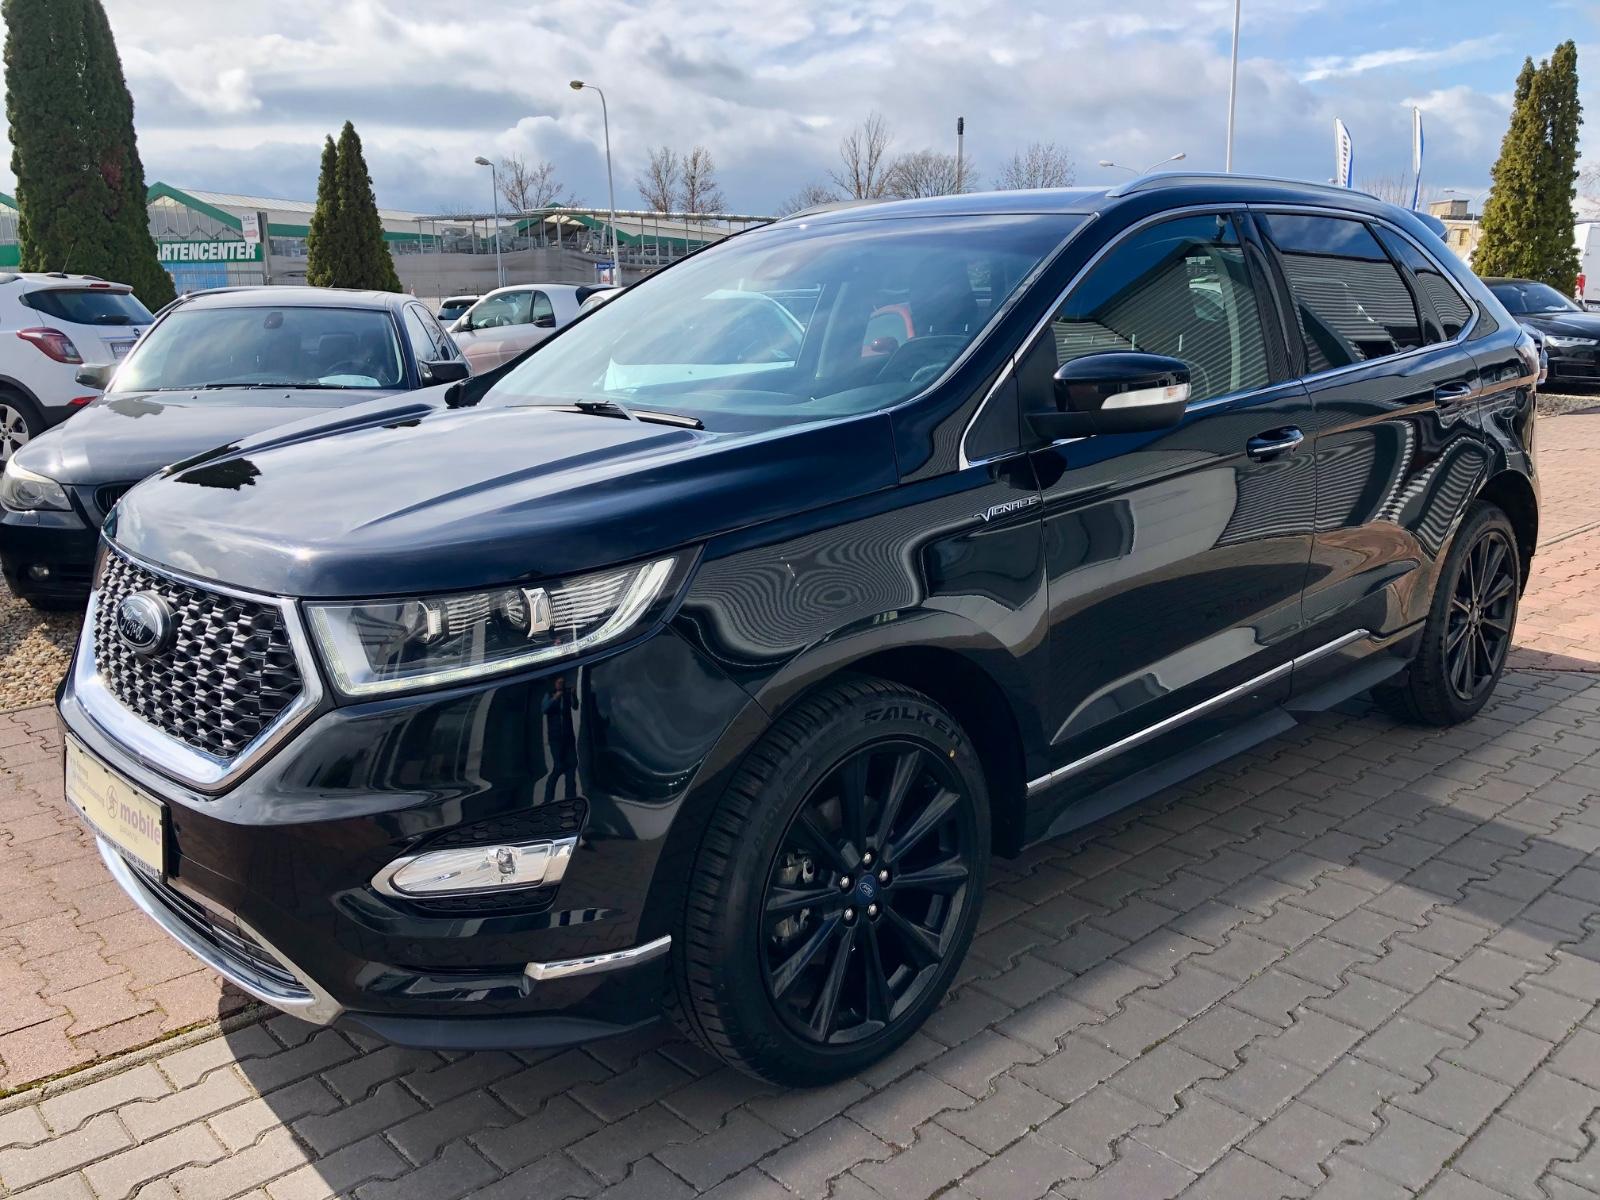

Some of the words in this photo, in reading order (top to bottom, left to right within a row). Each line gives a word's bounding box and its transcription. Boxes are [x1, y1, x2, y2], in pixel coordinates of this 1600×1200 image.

[157, 242, 256, 261] ARTENCENTER
[973, 494, 1038, 522] VIGNALE
[119, 605, 147, 641] Ford
[861, 705, 963, 747] FALKEN
[120, 802, 161, 846] mobile
